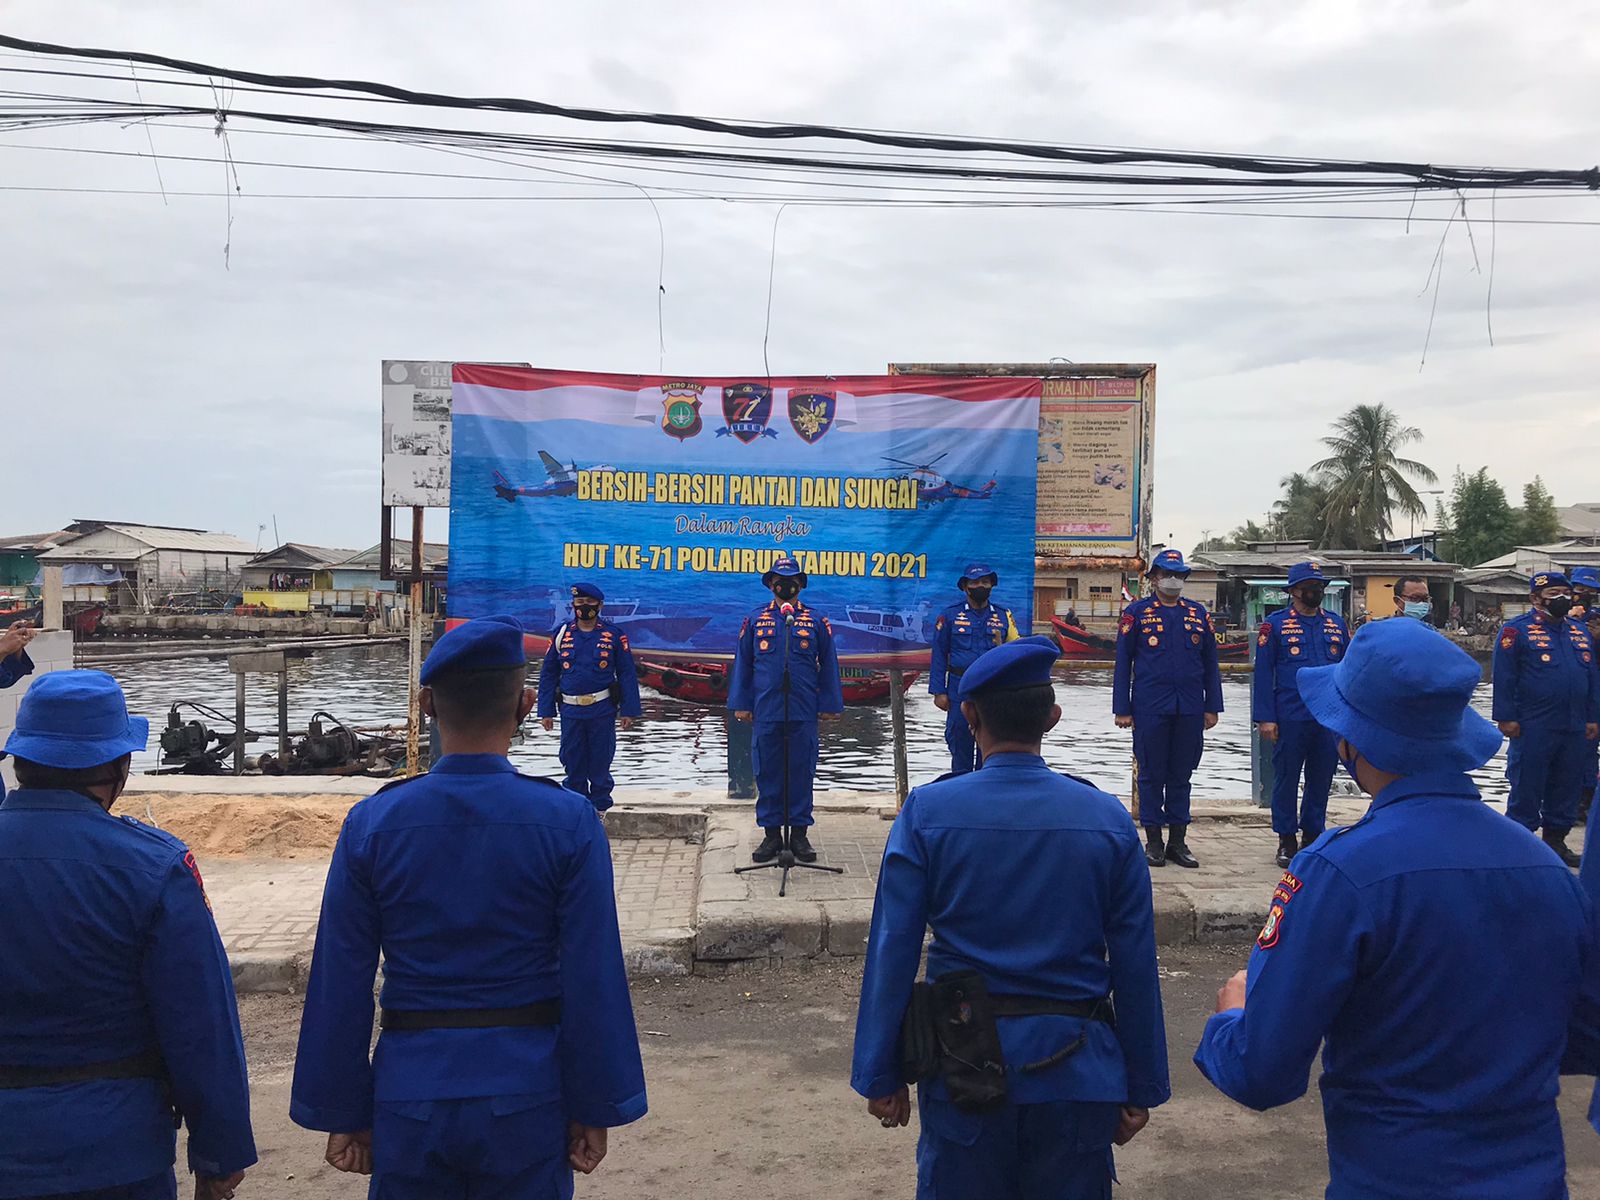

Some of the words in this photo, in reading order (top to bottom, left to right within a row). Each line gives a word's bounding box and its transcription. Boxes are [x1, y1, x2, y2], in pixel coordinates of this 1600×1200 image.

[687, 383, 702, 391] JAYA
[733, 397, 760, 421] 71
[577, 470, 725, 504] BERSIH-BERSIH
[729, 475, 796, 506] PANTAI
[800, 477, 840, 508] DAN
[844, 478, 918, 509] SUNGAI
[675, 512, 737, 534] Dalam
[738, 514, 812, 542] Rangka
[563, 543, 609, 568] HUT
[613, 545, 672, 571] KE-71
[792, 550, 866, 577] TAHUN
[870, 552, 927, 579] 2021
